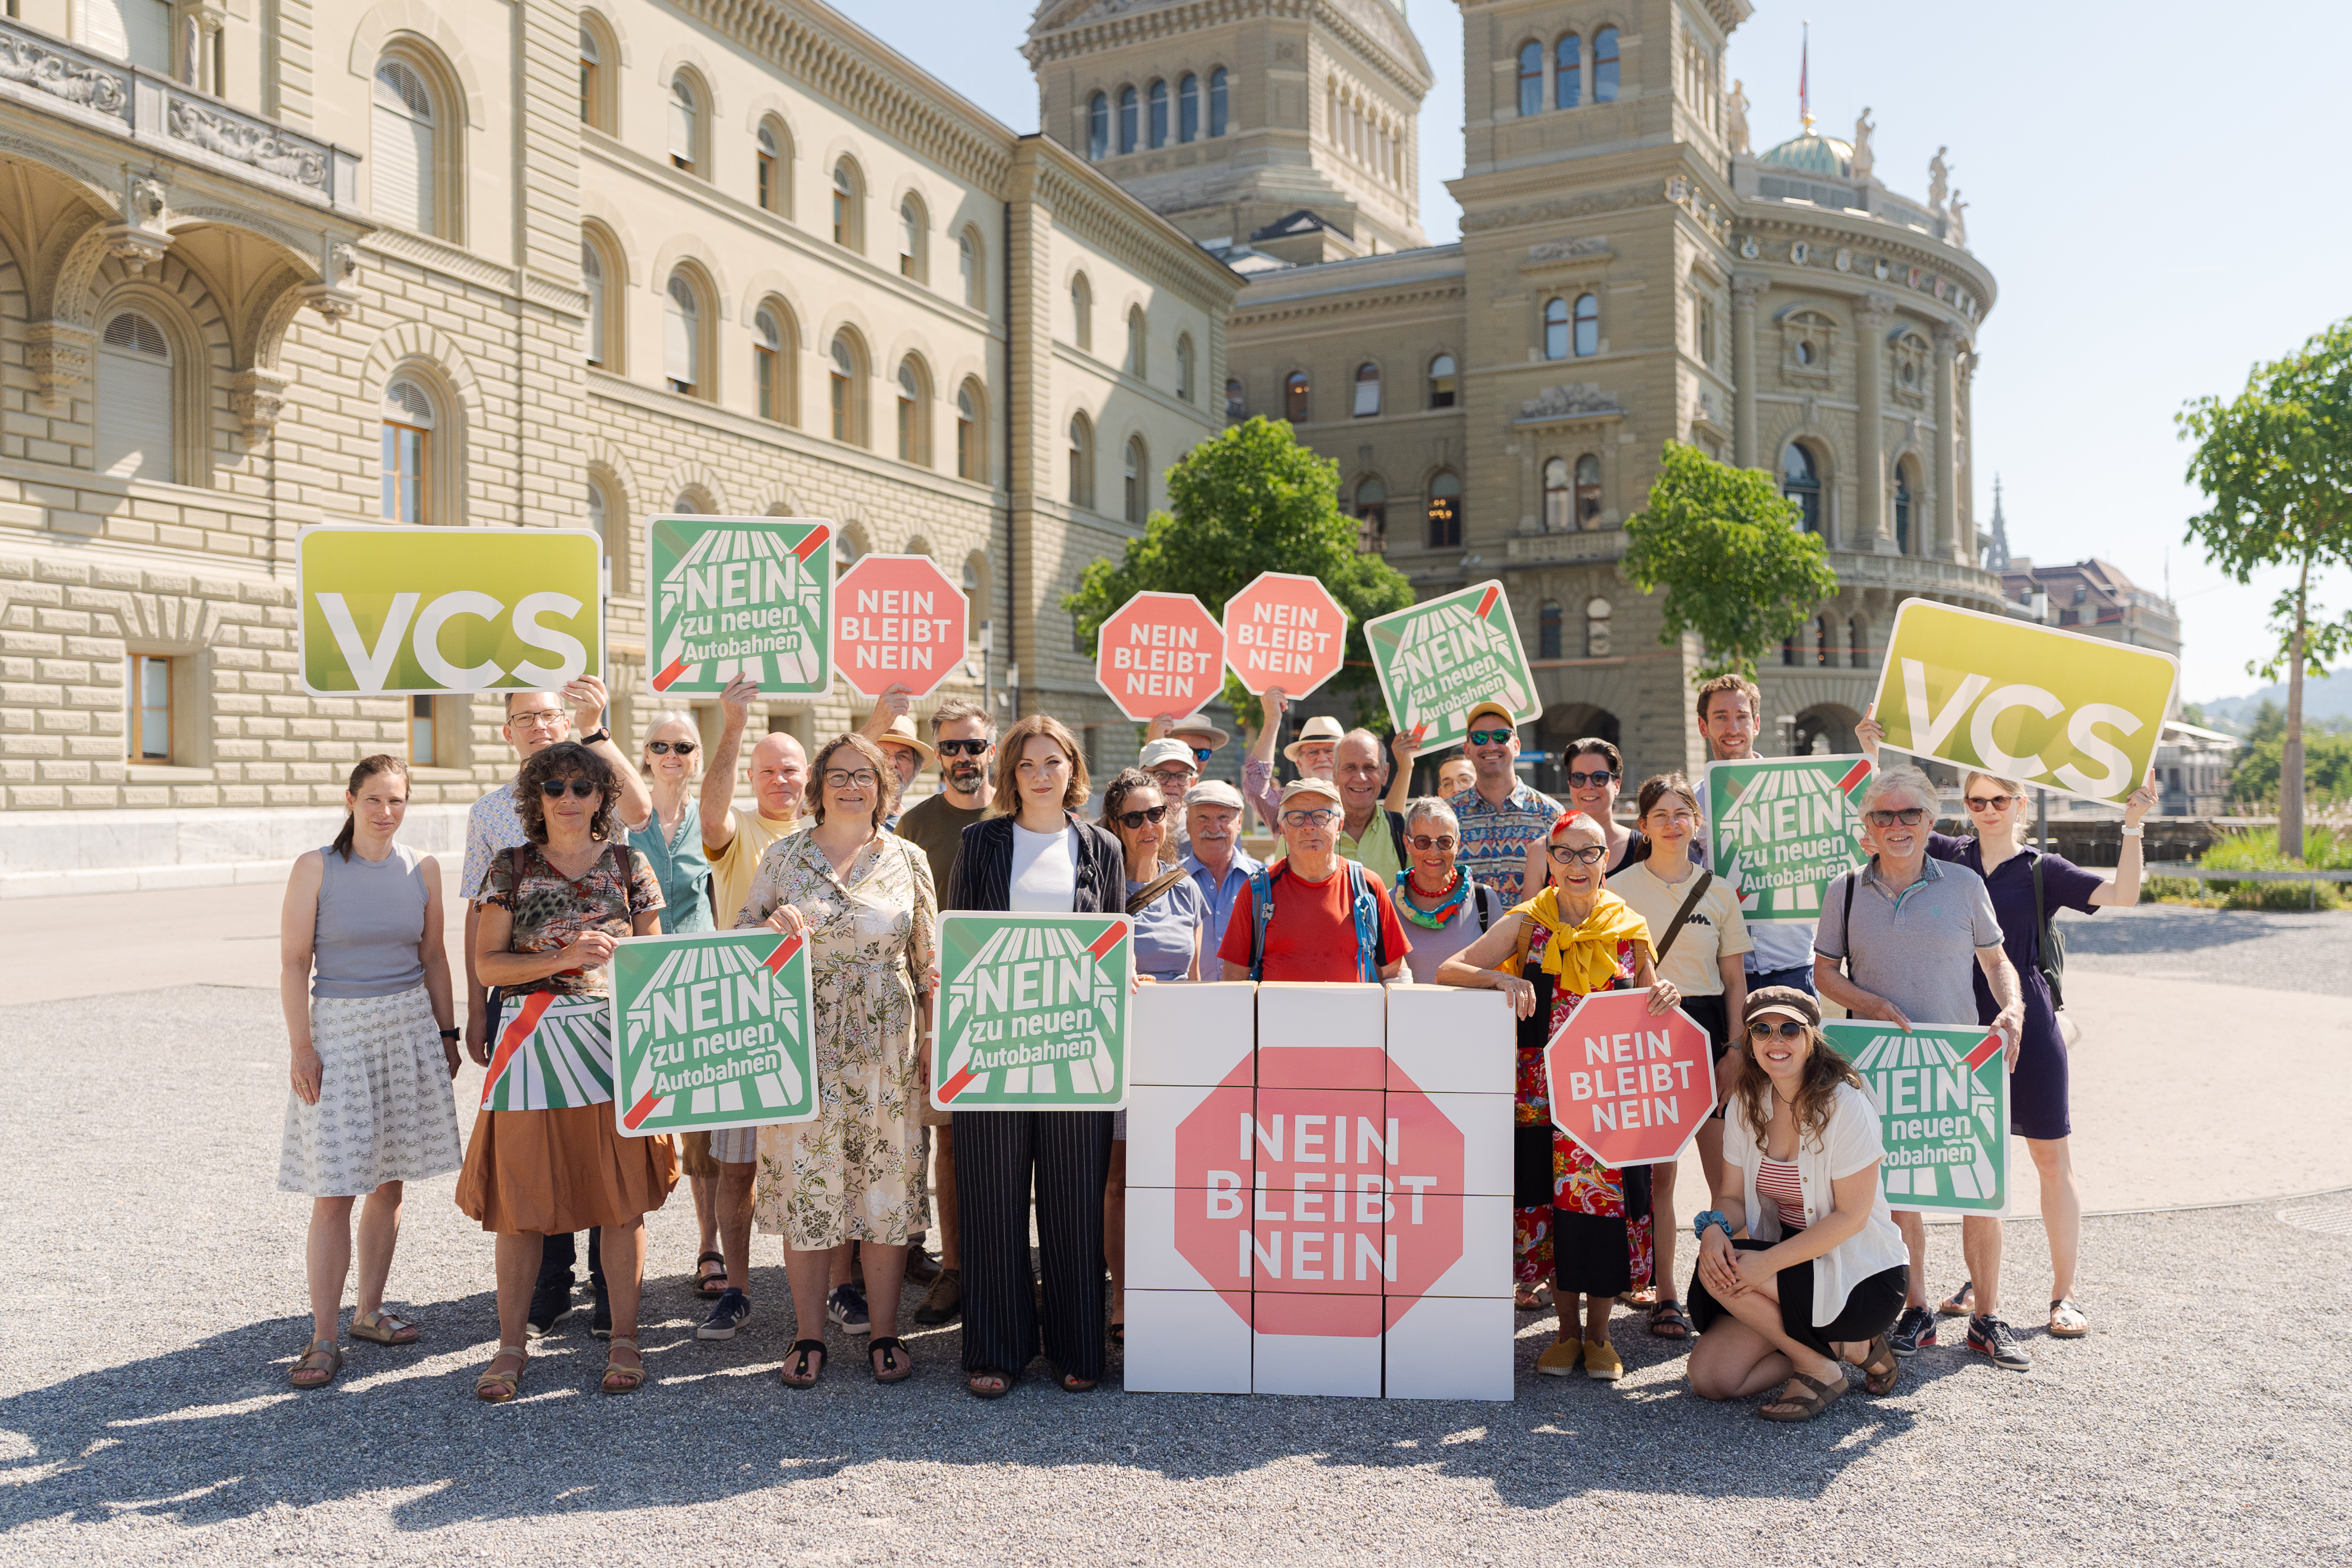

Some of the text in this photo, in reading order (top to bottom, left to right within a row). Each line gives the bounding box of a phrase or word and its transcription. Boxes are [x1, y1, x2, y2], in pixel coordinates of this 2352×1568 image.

[687, 557, 796, 611] NEIN
[858, 590, 933, 614] NEIN
[684, 606, 797, 637] zu neuen
[841, 617, 951, 643] BLEIBT
[1254, 602, 1318, 628] NEIN
[315, 590, 587, 690] VCS
[683, 634, 797, 661] Autobahnen
[1131, 623, 1197, 648] NEIN
[1238, 624, 1331, 653] BLEIBT
[1404, 617, 1489, 685] NEIN
[857, 645, 932, 670] NEIN
[1114, 647, 1211, 674] BLEIBT
[1248, 649, 1312, 675] NEIN
[1127, 673, 1193, 697] NEIN
[1414, 655, 1496, 705] zu neuen
[1422, 676, 1504, 724] Autobahnen
[1901, 657, 2144, 798] VCS
[1742, 790, 1842, 846] NEIN
[1742, 836, 1845, 868] zu neuen
[976, 955, 1091, 1015] NEIN
[653, 969, 771, 1040] NEIN
[972, 1008, 1091, 1043] zu neuen
[653, 1022, 774, 1067] zu neuen
[971, 1040, 1091, 1070] Autobahnen
[1585, 1029, 1671, 1065] NEIN
[654, 1050, 777, 1094] Autobahnen
[1570, 1061, 1693, 1101] BLEIBT
[1592, 1096, 1679, 1132] NEIN
[1892, 1116, 1970, 1140] neuen
[1241, 1113, 1398, 1165] NEIN
[1207, 1170, 1436, 1225] BLEIBT
[1240, 1230, 1397, 1282] NEIN
